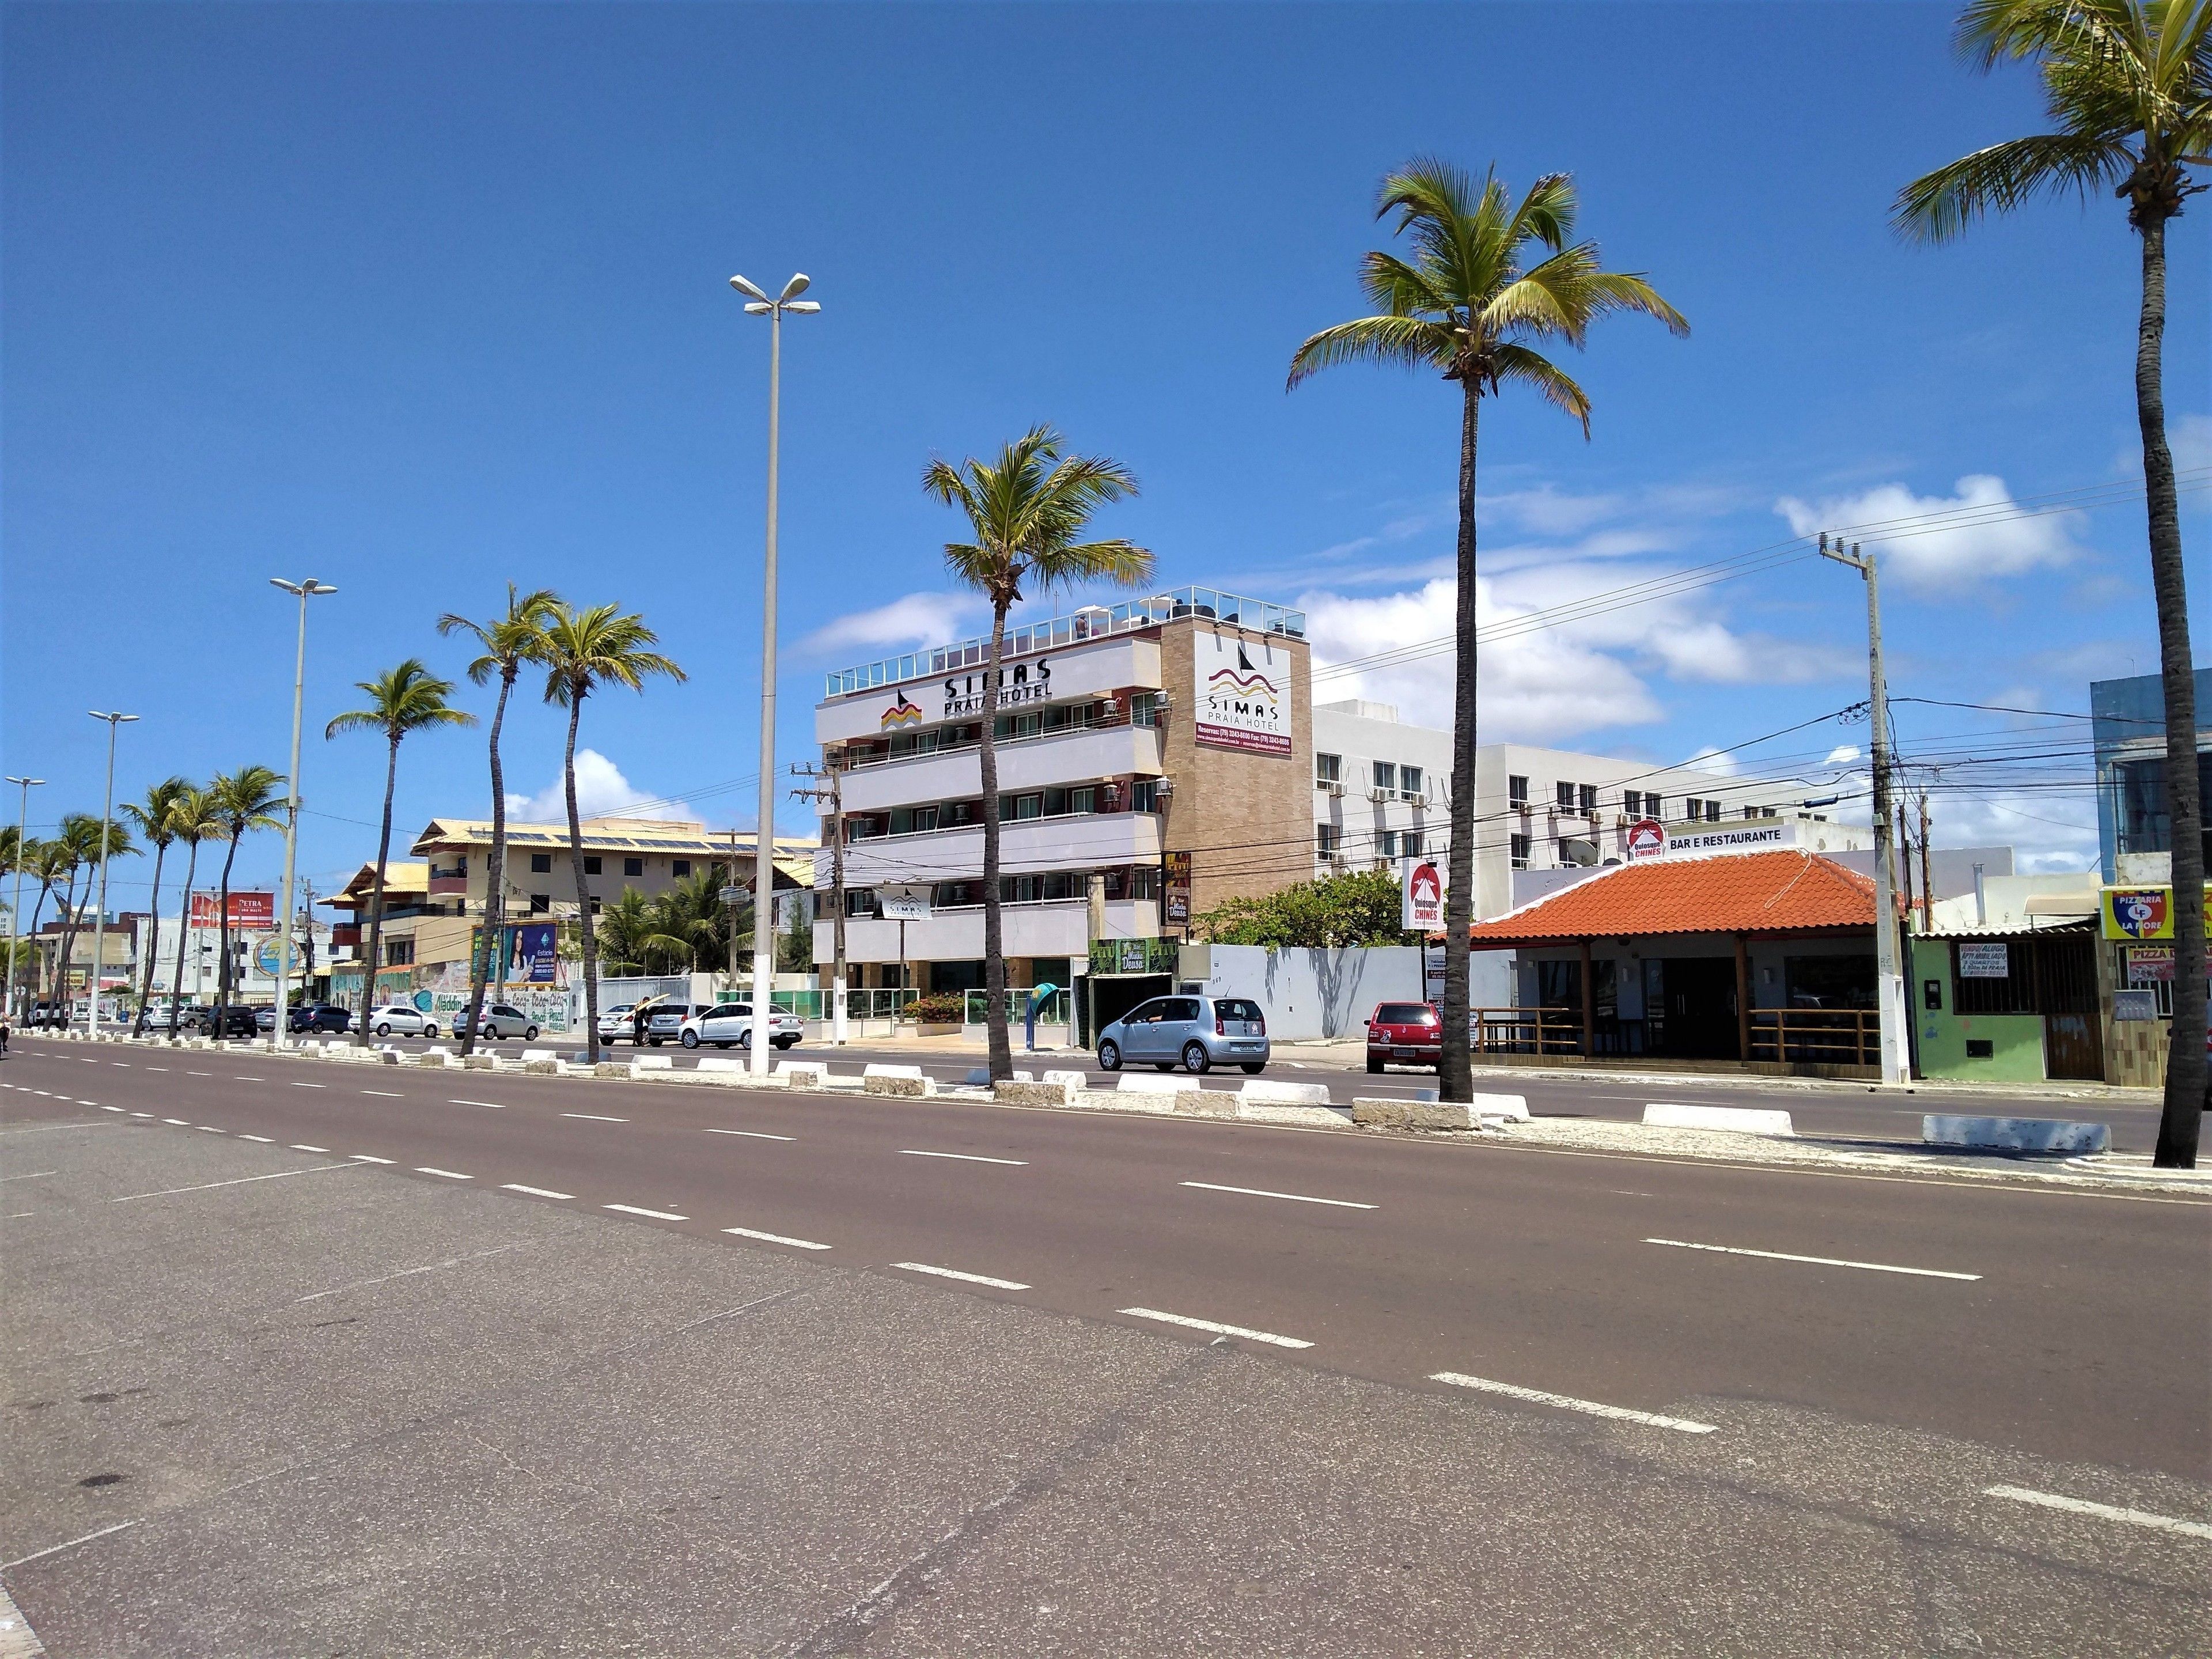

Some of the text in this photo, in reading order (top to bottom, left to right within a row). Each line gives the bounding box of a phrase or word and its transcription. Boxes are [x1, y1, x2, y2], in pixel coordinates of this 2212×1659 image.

[1001, 683, 1052, 703] HOTEL
[1209, 696, 1278, 719] SIMAS
[1209, 712, 1279, 731] PRAIA HOTEL
[1198, 725, 1219, 735] Reservas:
[1220, 729, 1228, 737] (79)
[1229, 730, 1250, 740] 3243-8600
[1635, 842, 1661, 850] Quiosque
[1671, 830, 1781, 850] BAR E RESTAURANTE
[1415, 898, 1437, 910] Quiosque
[2120, 896, 2161, 904] PIZZARIA
[1169, 907, 1187, 917] Deusa
[2135, 906, 2146, 918] LF
[1128, 951, 1143, 960] Minha
[2134, 950, 2166, 959] PIZZA
[1122, 956, 1144, 969] Deusa
